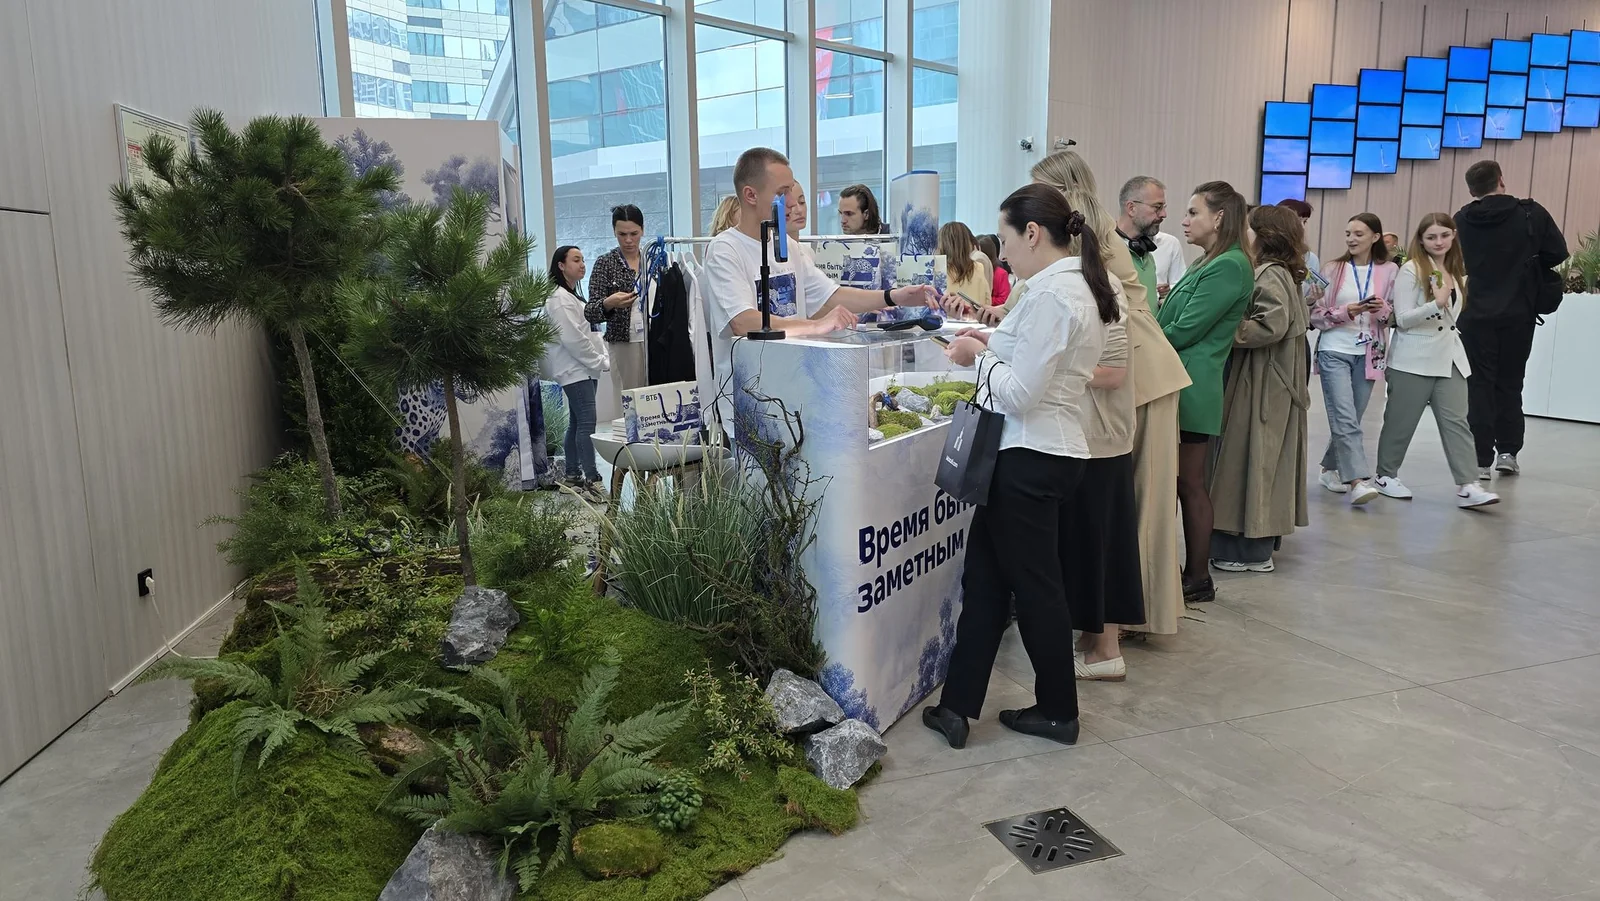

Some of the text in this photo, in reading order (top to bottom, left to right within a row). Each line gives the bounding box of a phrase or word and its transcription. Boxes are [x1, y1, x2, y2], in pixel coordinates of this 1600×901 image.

[826, 262, 843, 270] быть
[640, 414, 660, 422] Время
[858, 506, 929, 568] Время
[858, 528, 964, 613] заметным
